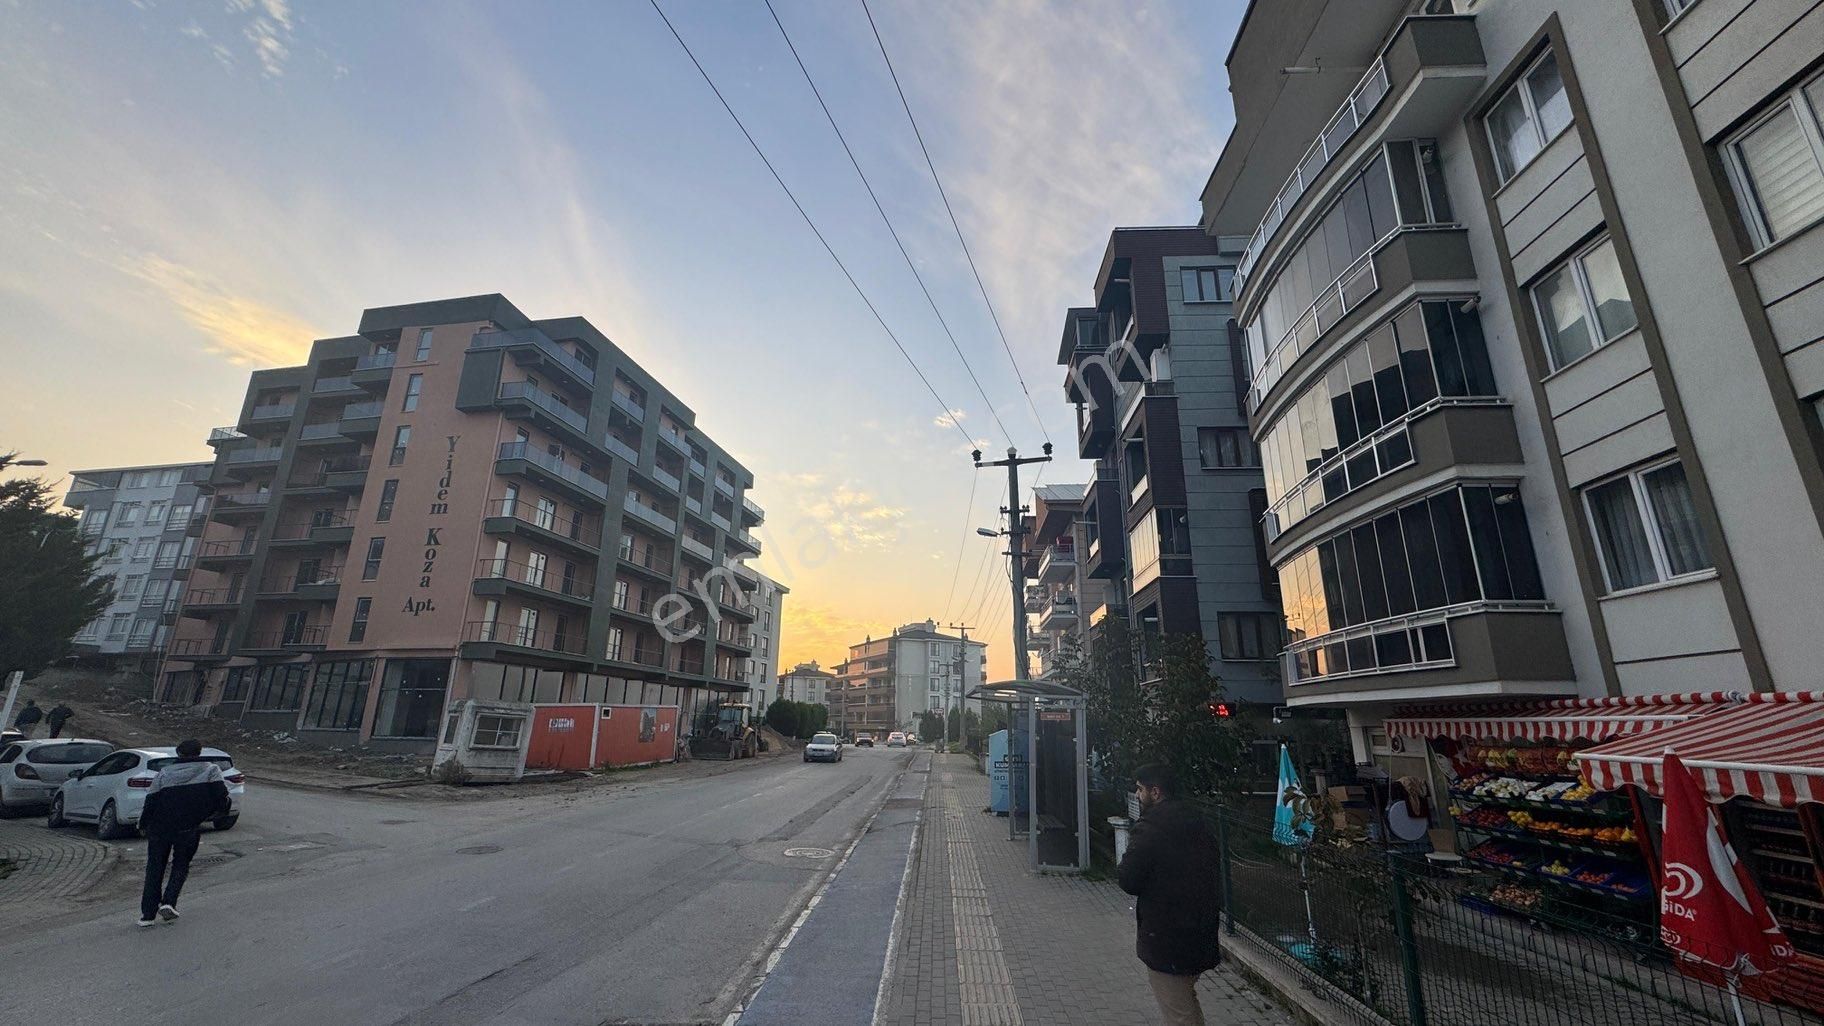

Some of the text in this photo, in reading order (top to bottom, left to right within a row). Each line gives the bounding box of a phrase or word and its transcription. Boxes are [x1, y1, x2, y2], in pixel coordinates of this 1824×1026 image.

[402, 435, 461, 617] Yidem Koza Apt.
